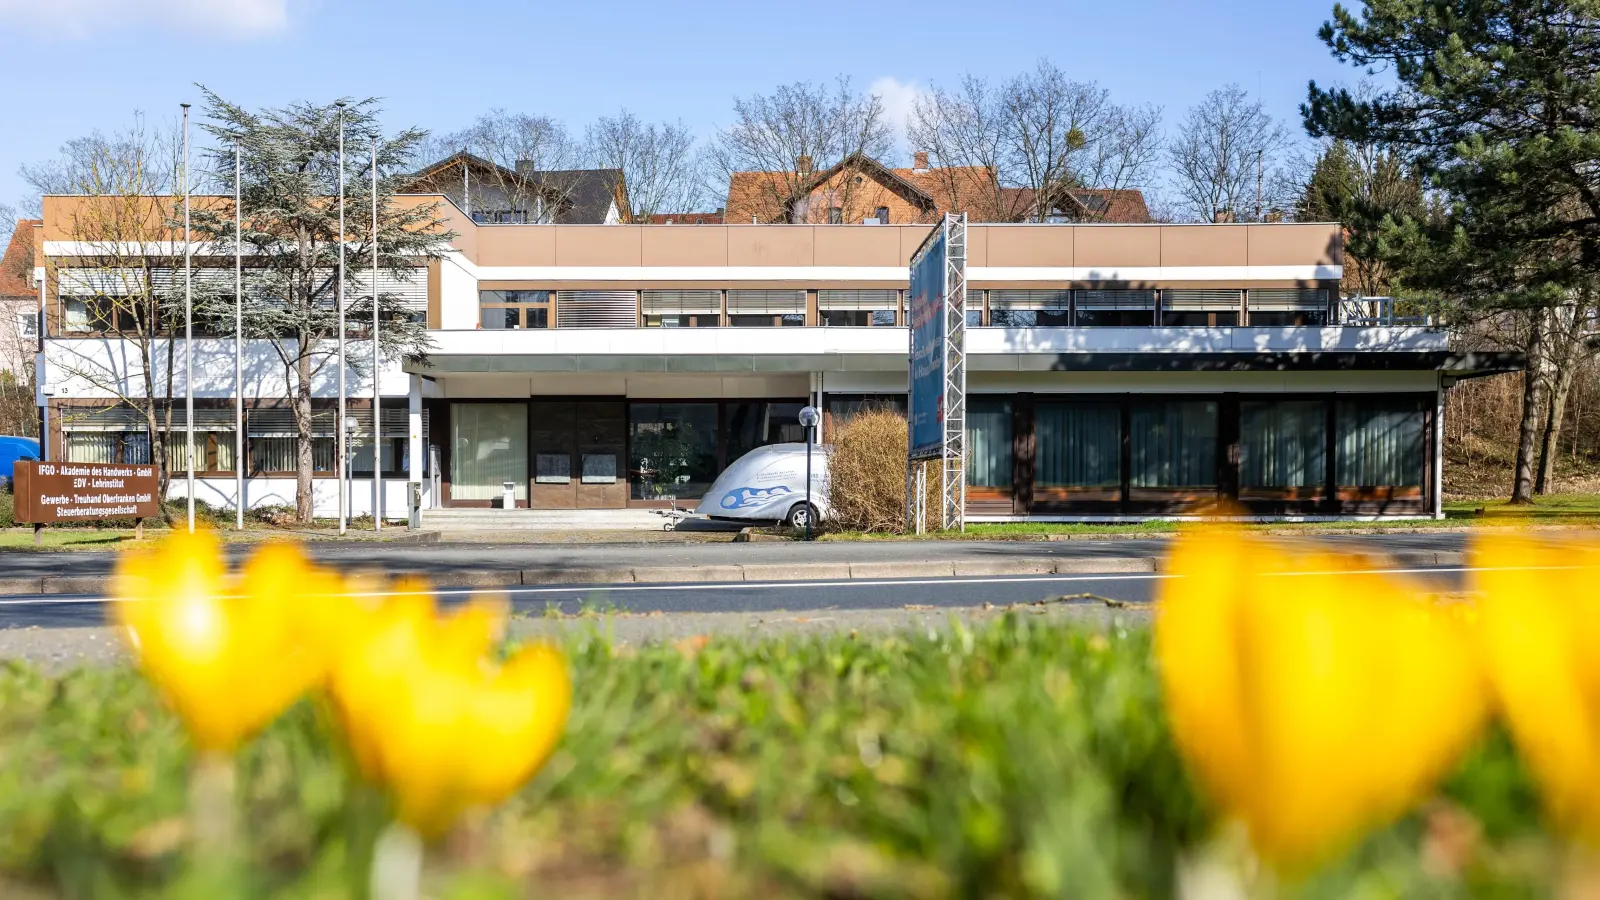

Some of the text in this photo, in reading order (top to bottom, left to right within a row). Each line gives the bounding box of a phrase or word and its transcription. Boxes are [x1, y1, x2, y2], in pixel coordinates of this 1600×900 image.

[38, 464, 55, 476] IFGO
[60, 465, 90, 476] Akademie
[91, 466, 102, 476] des
[102, 466, 133, 477] Handwerks
[136, 467, 152, 477] GmbH
[73, 477, 87, 488] EDV
[91, 478, 124, 488] Lehrinstitut
[41, 494, 69, 505] Gewerbe
[73, 493, 101, 504] Treuhand
[102, 493, 136, 504] Oberfranken
[136, 493, 152, 503] GmbH
[56, 504, 138, 518] Steuerberatungsgesellschaft
